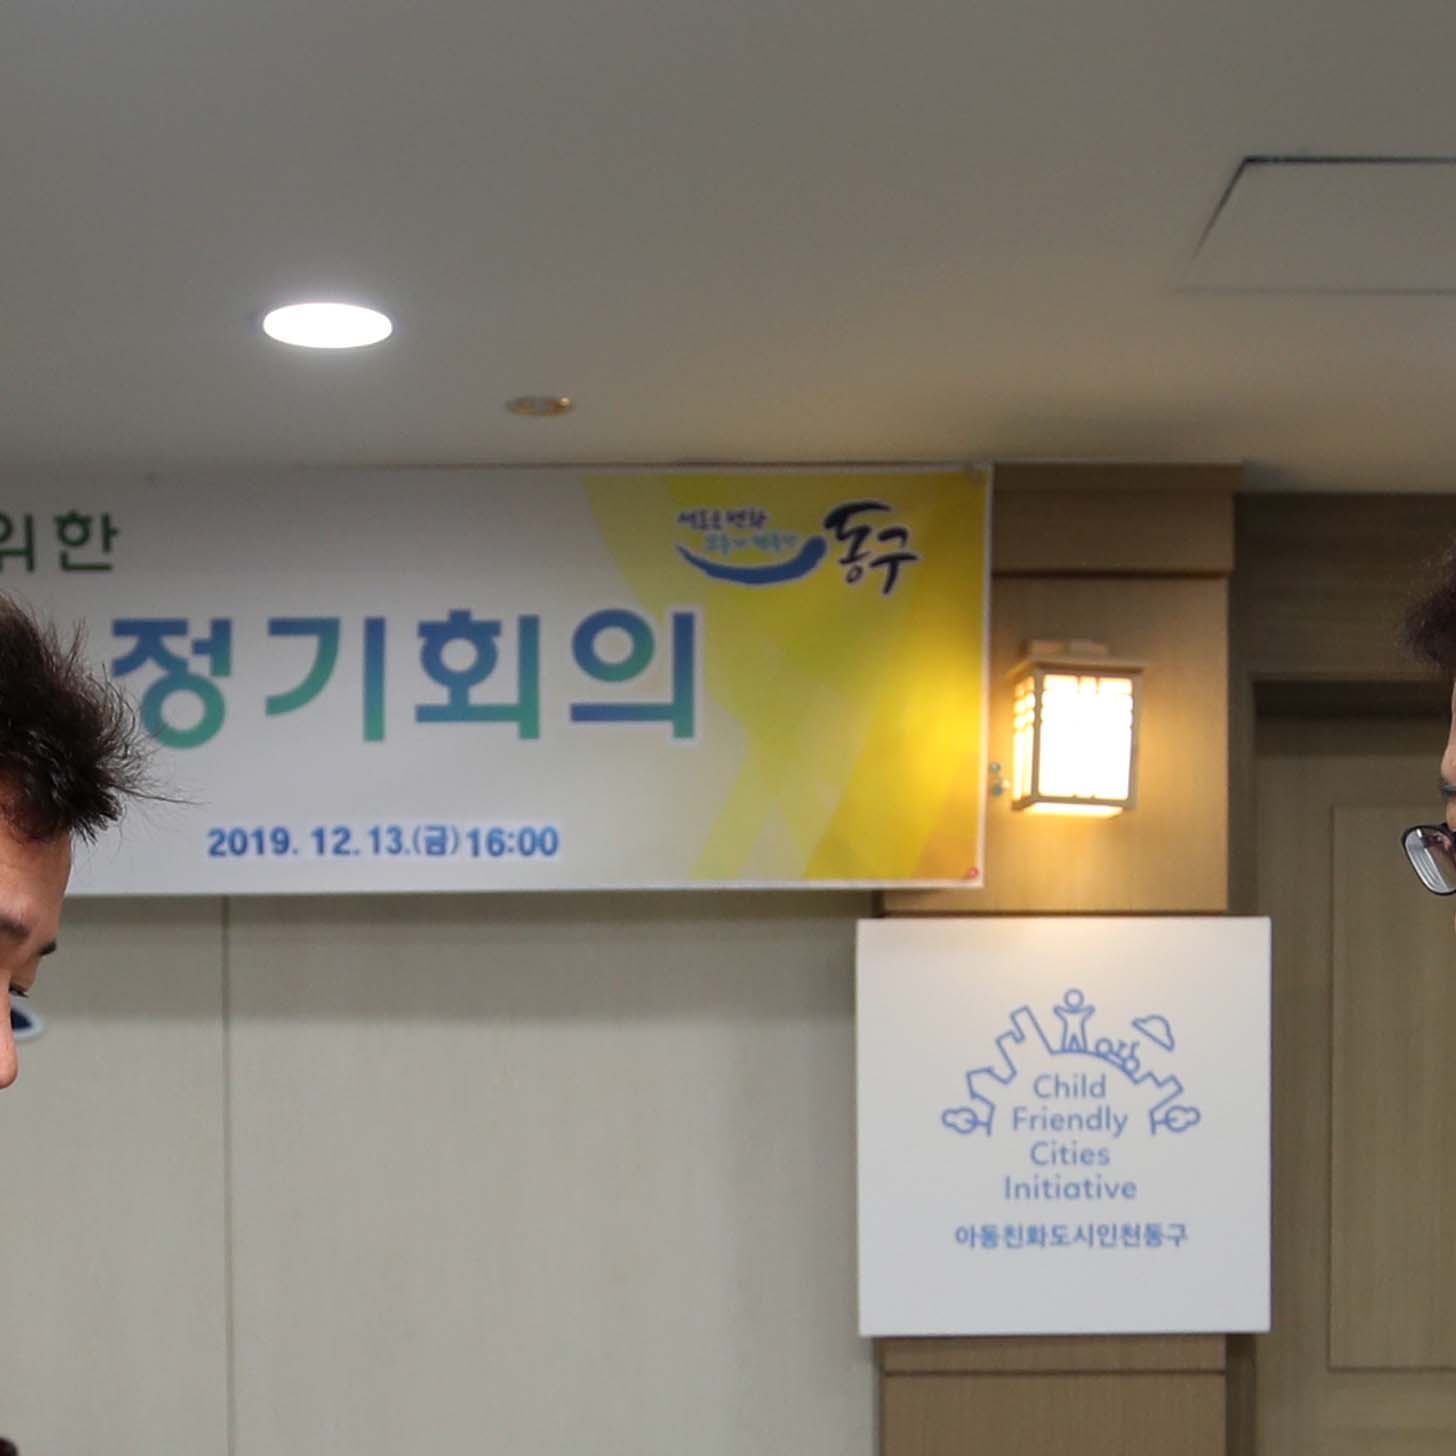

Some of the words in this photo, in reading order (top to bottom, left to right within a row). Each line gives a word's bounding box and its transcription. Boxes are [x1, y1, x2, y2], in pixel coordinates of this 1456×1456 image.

[823, 500, 919, 595] 동구
[109, 607, 697, 750] 정기회의
[1032, 1072, 1106, 1100] Child
[1011, 1105, 1128, 1138] Friendly
[1029, 1140, 1111, 1167] Cities
[1004, 1174, 1138, 1201] Initiative
[954, 1222, 1189, 1250] 아동친화도시인천동구
